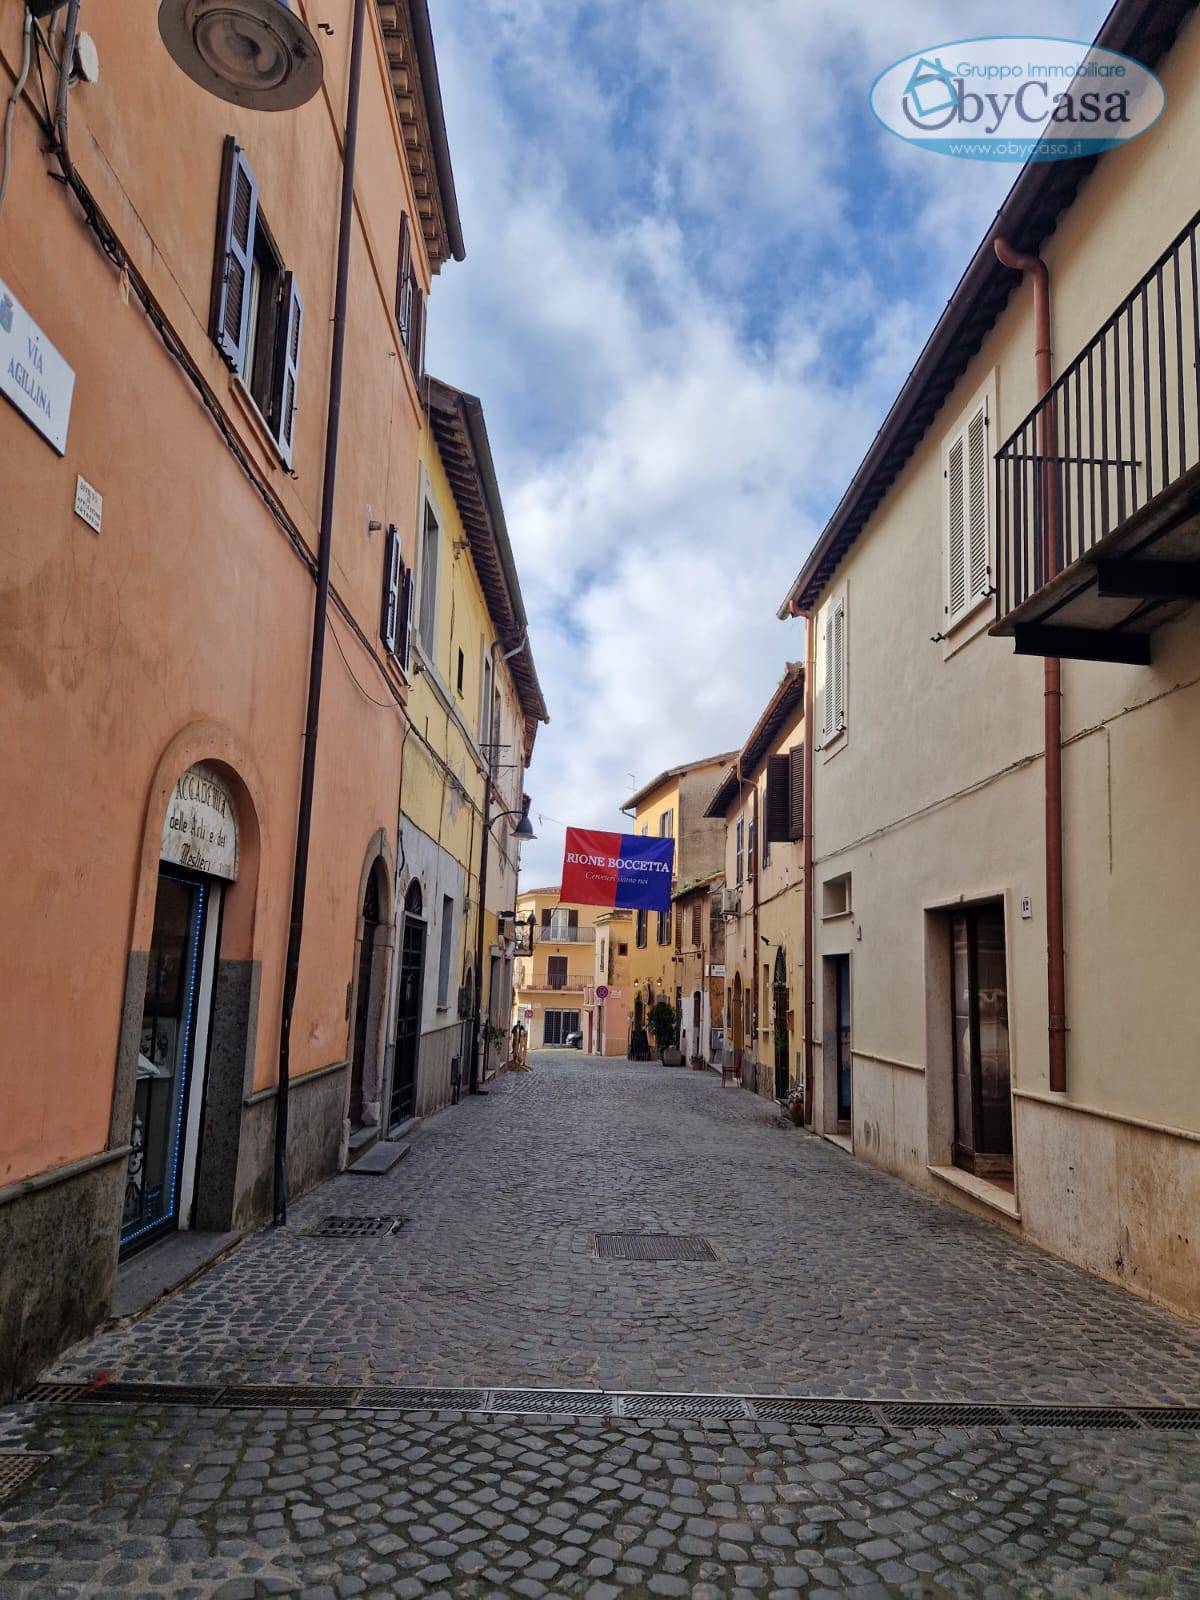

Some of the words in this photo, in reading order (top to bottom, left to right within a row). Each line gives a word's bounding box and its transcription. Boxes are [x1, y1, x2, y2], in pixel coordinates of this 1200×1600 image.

[28, 337, 43, 376] VIA
[8, 357, 51, 419] AGILLINA
[175, 776, 226, 818] ACCADEMIA
[169, 808, 188, 833] delle
[209, 831, 214, 843] e
[567, 852, 605, 867] RIONE
[608, 858, 670, 873] BOCCETTA
